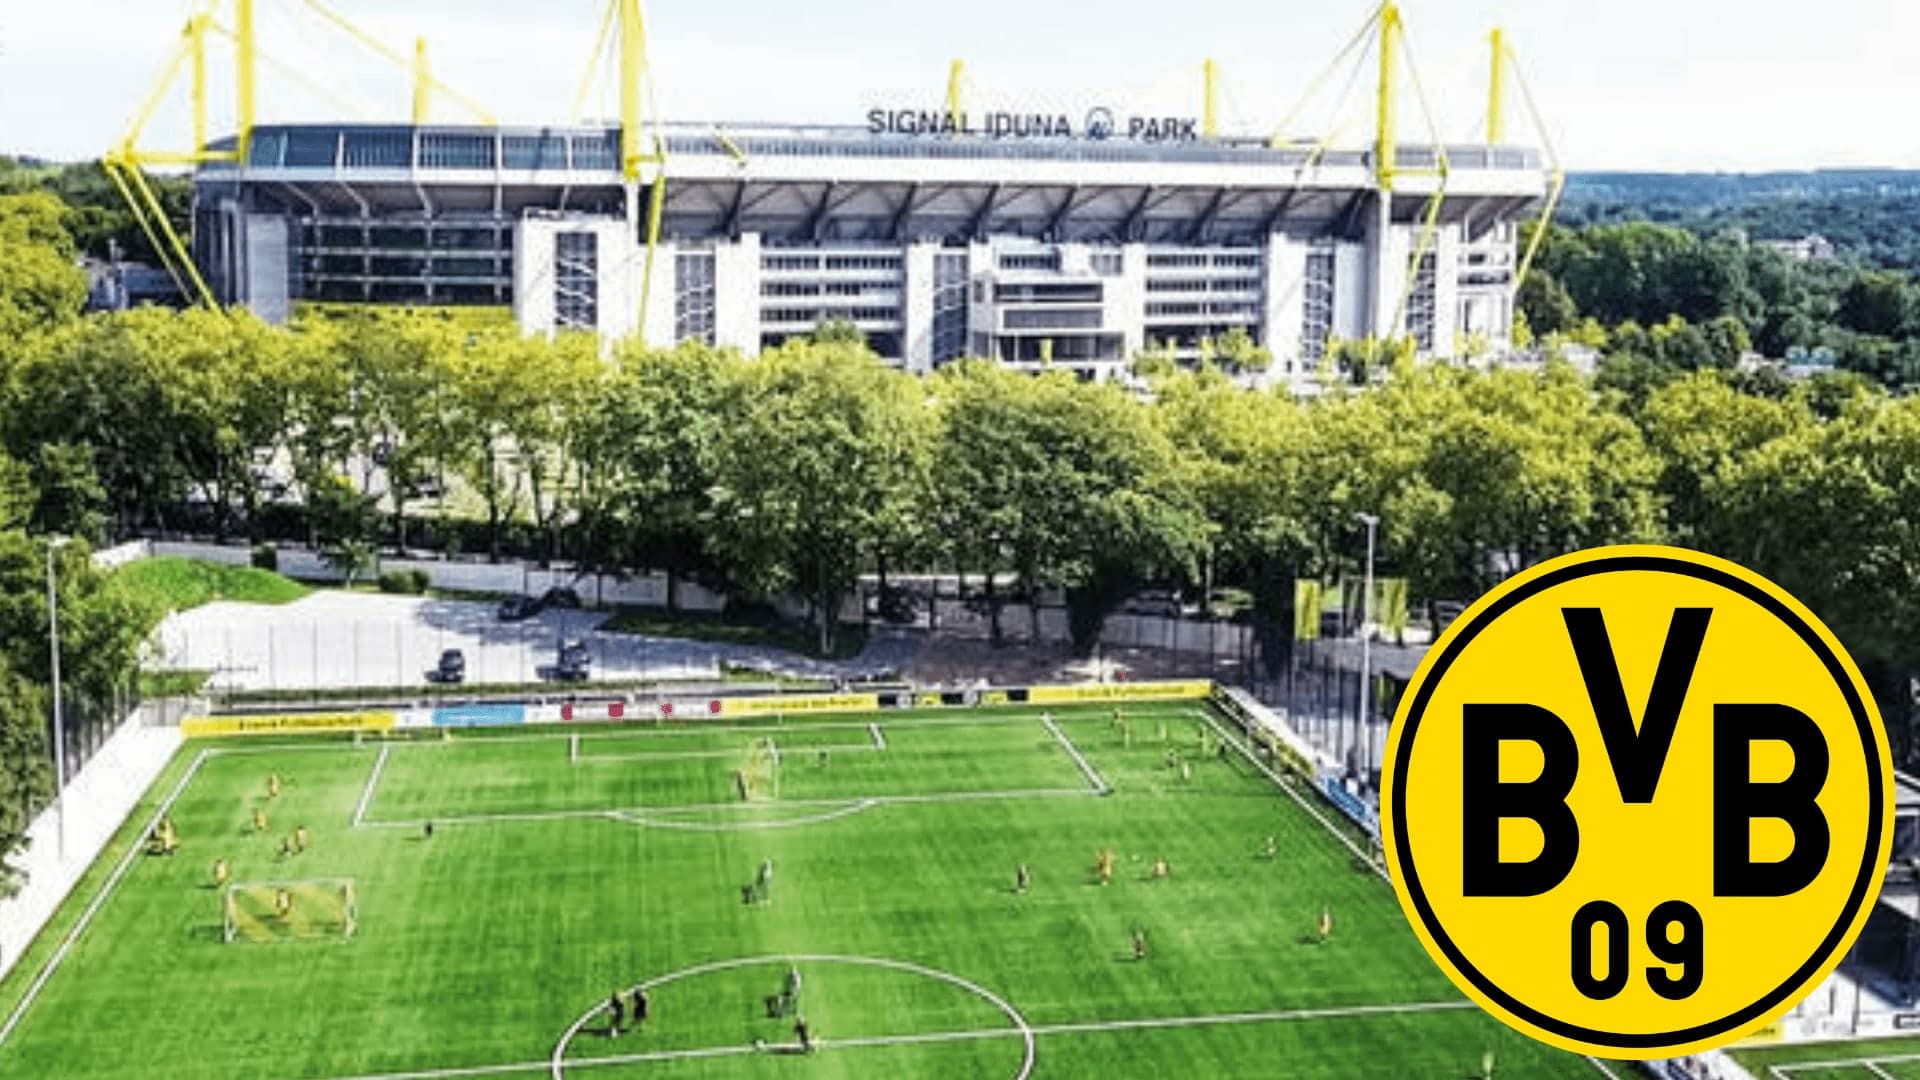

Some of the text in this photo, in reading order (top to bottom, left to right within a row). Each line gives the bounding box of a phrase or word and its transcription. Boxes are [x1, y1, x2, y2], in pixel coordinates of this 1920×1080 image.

[867, 109, 1198, 141] SIGNAL IDUNA PARK
